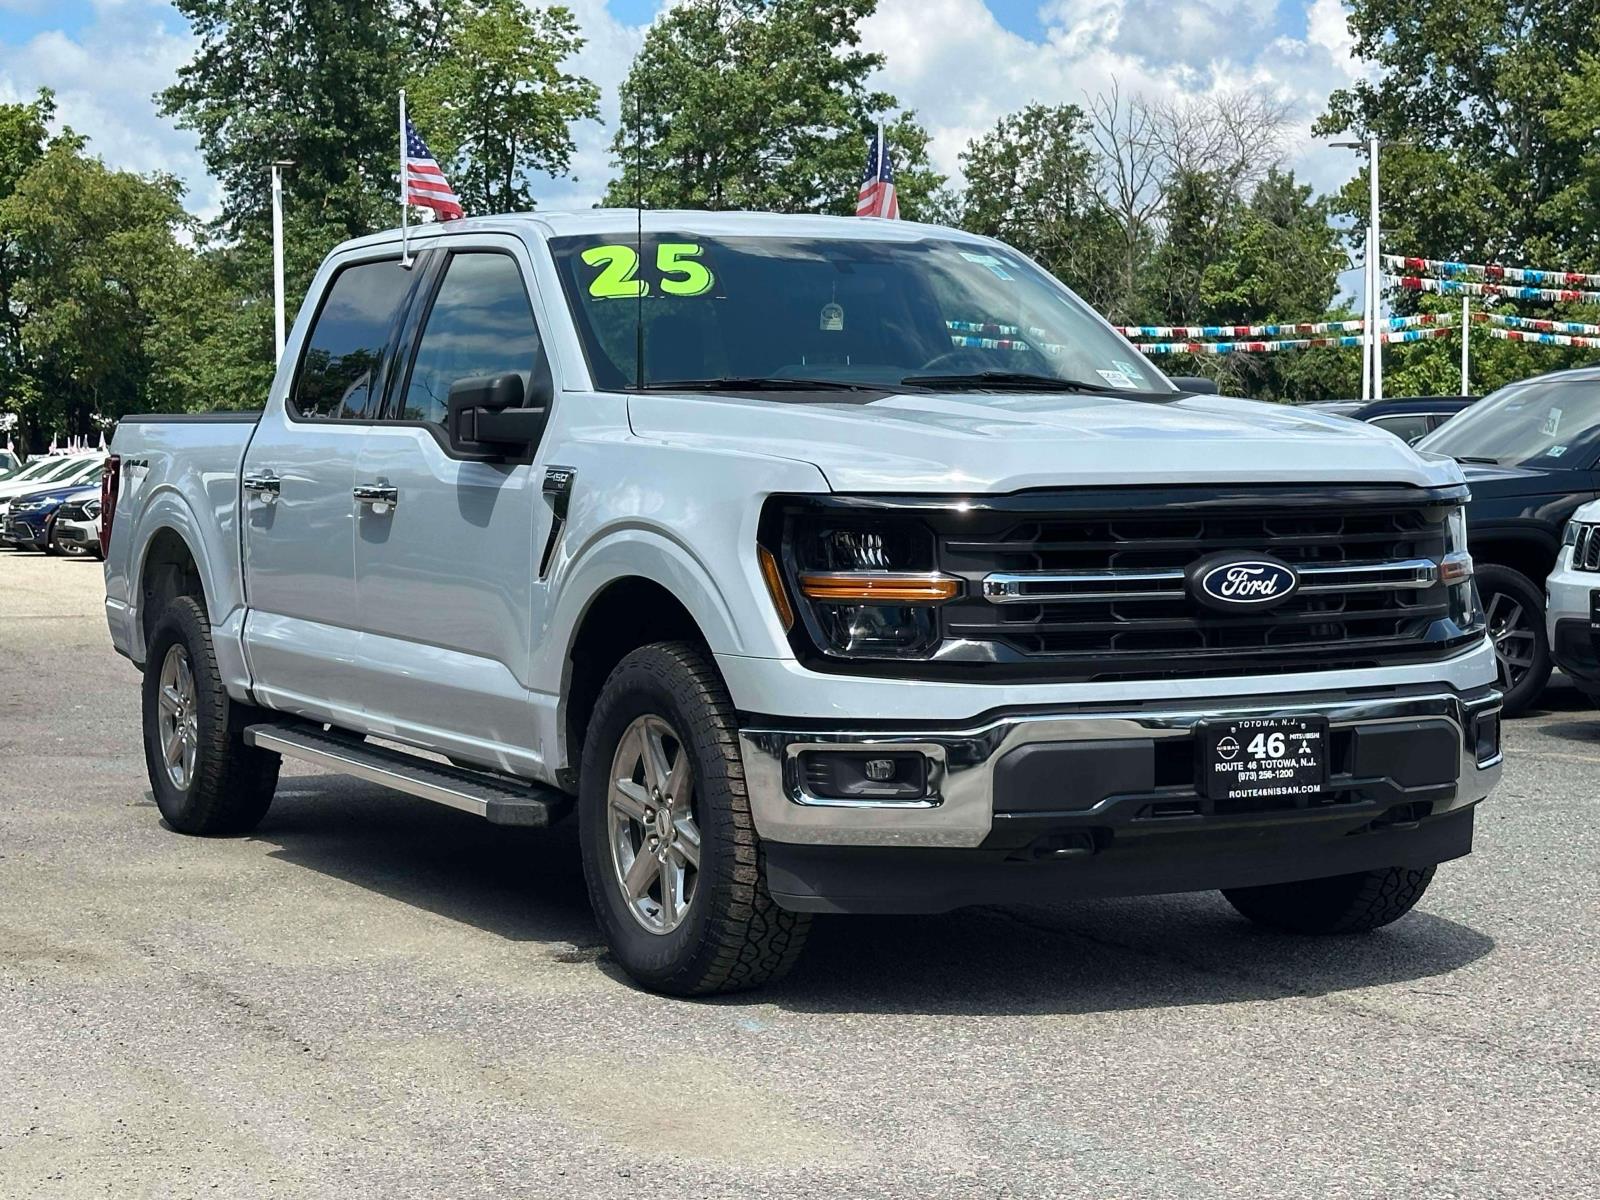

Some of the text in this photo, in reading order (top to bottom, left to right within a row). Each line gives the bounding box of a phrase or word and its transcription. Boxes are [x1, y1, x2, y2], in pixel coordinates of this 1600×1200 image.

[581, 243, 715, 299] 25
[1221, 567, 1278, 596] Ford
[1239, 718, 1298, 728] TOTOWA, N.J.
[1289, 732, 1320, 740] MITSUBISHI
[1247, 732, 1286, 759] 46
[1215, 757, 1317, 772] ROUTE 46 TOTOWA, N.J.
[1238, 769, 1294, 782] (973) 256-1200
[1229, 785, 1321, 798] ROUTE46NISSAN.COM
